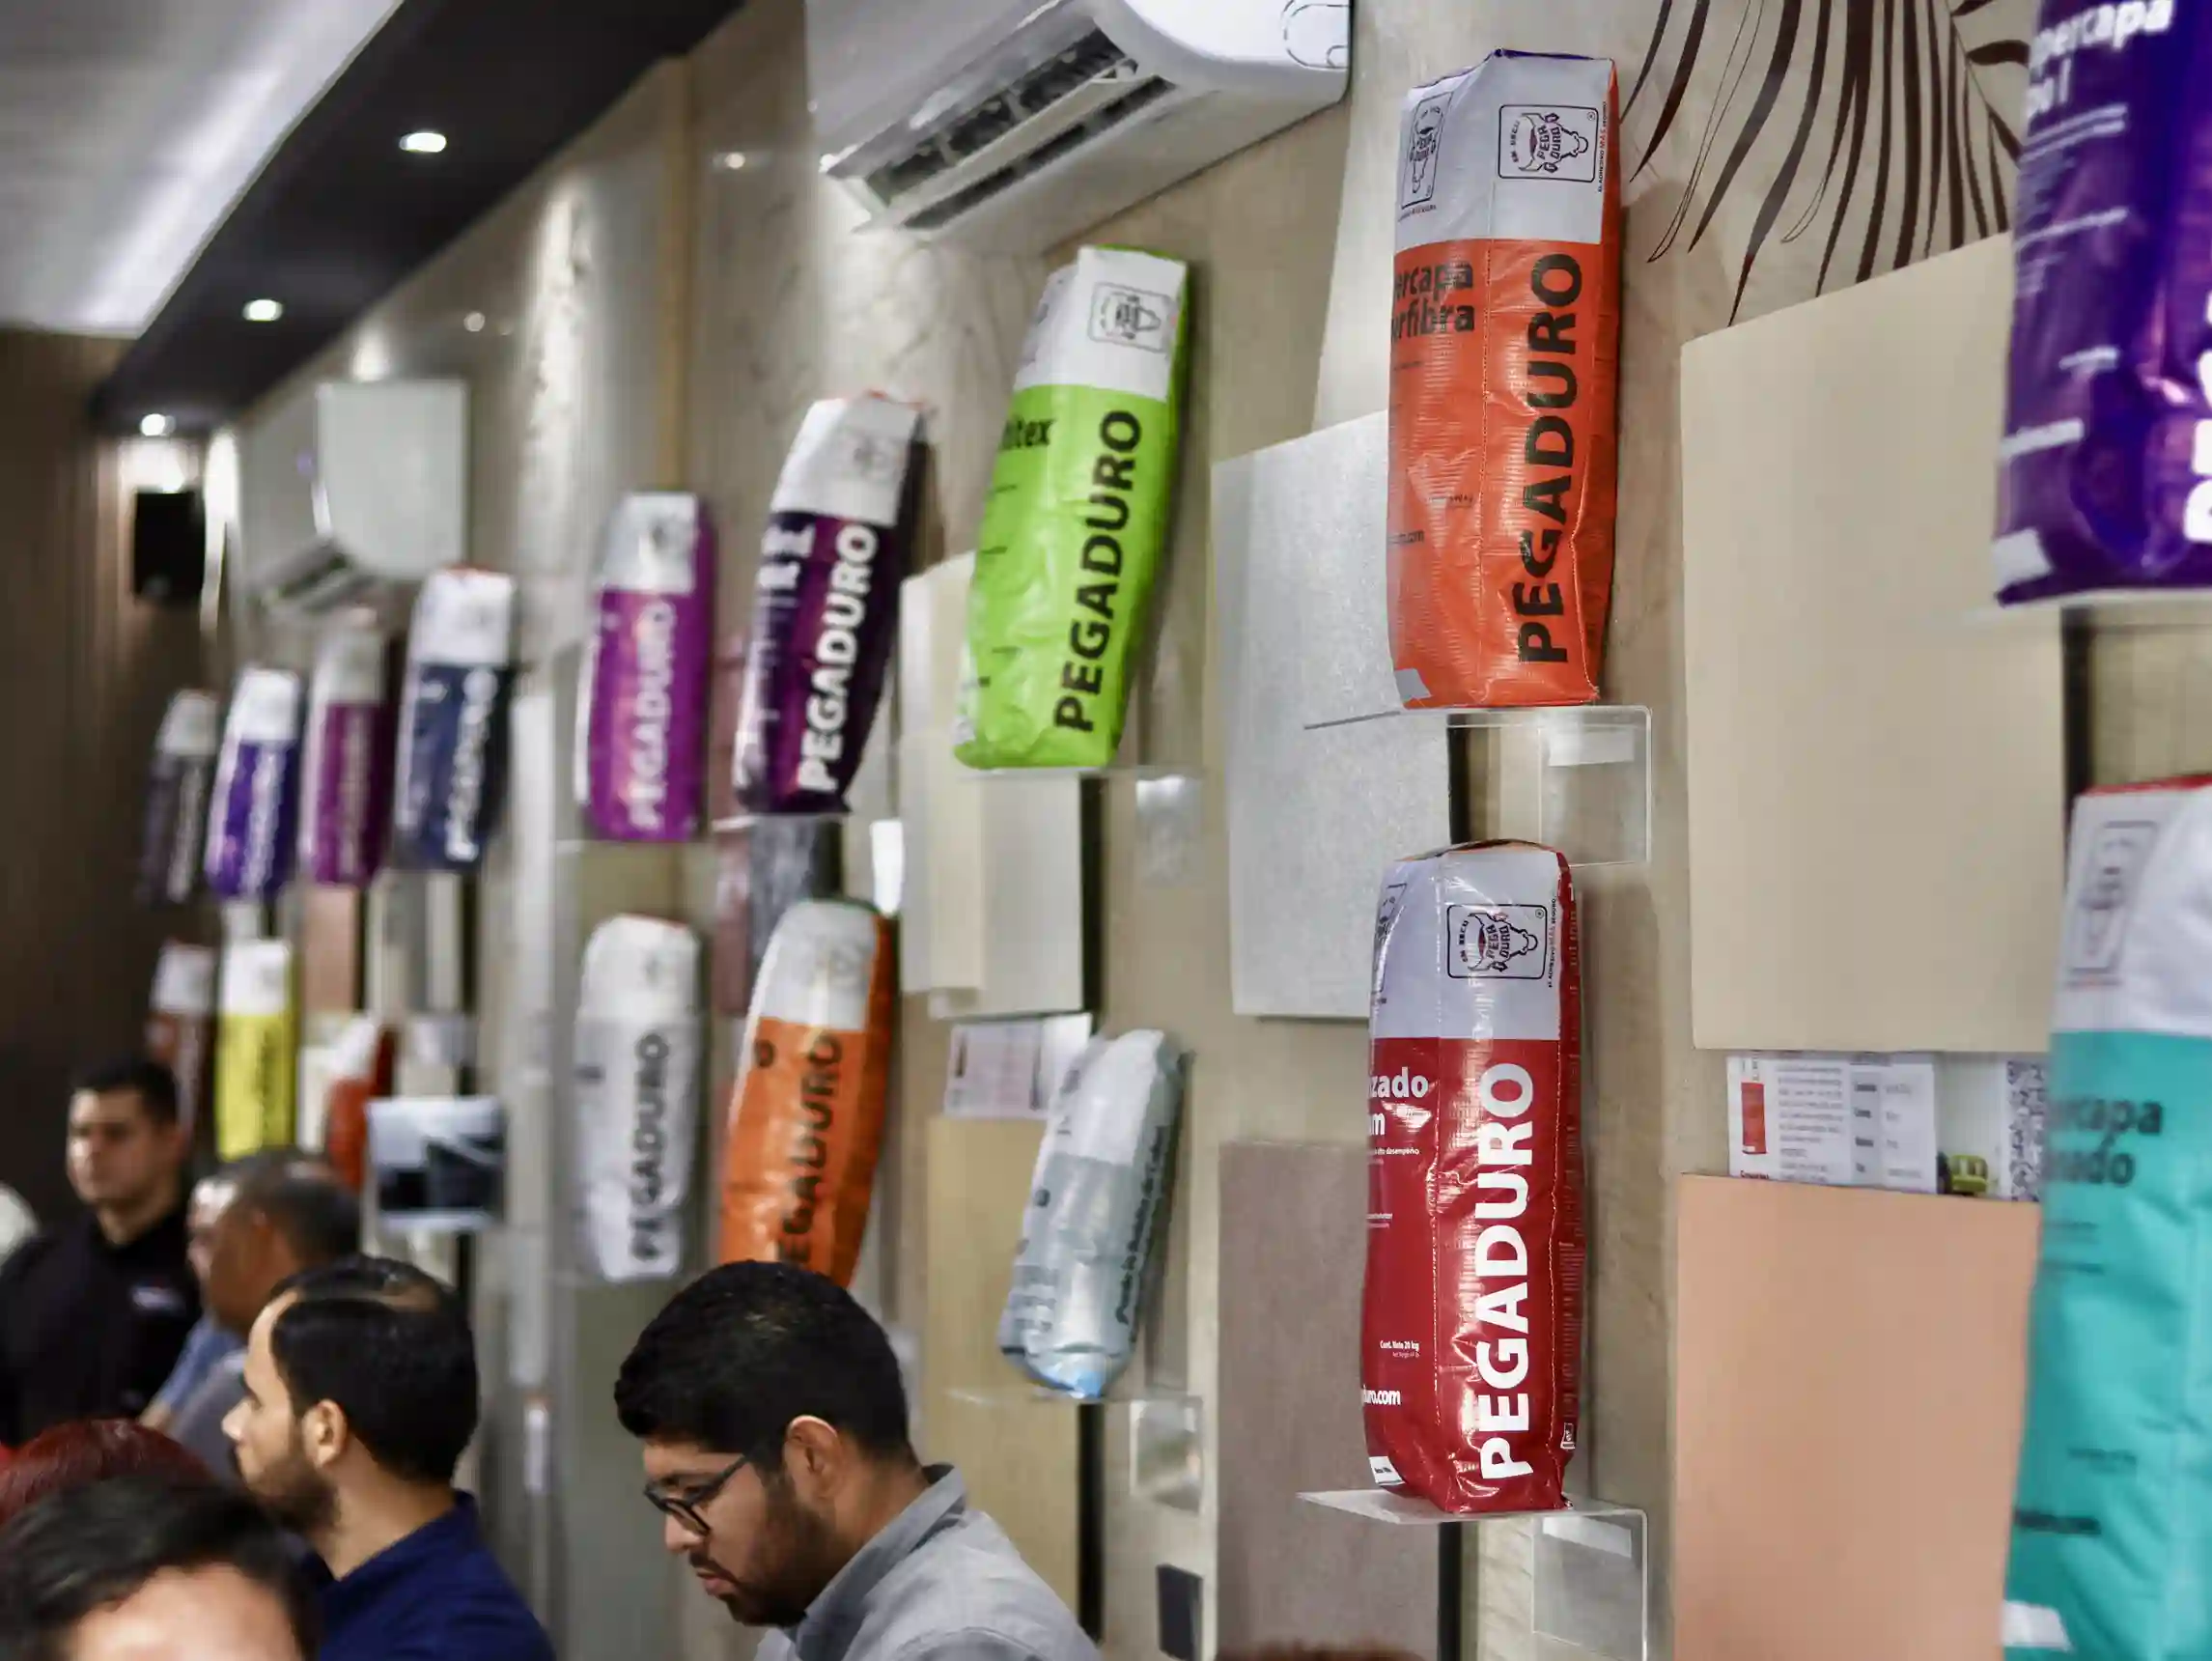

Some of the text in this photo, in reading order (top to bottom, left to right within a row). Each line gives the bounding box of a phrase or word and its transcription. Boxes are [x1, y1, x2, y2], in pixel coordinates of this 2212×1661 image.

[1536, 125, 1550, 160] PEGA
[1549, 126, 1561, 159] DURO
[1053, 410, 1141, 732] PEGADURO
[1513, 254, 1582, 663] PEGADURO
[798, 524, 878, 792] PEGADURO
[1485, 924, 1499, 959] PEGA
[1498, 925, 1511, 959] DURO
[778, 1033, 843, 1265] EGADURO
[1474, 1063, 1535, 1479] PEGADURO
